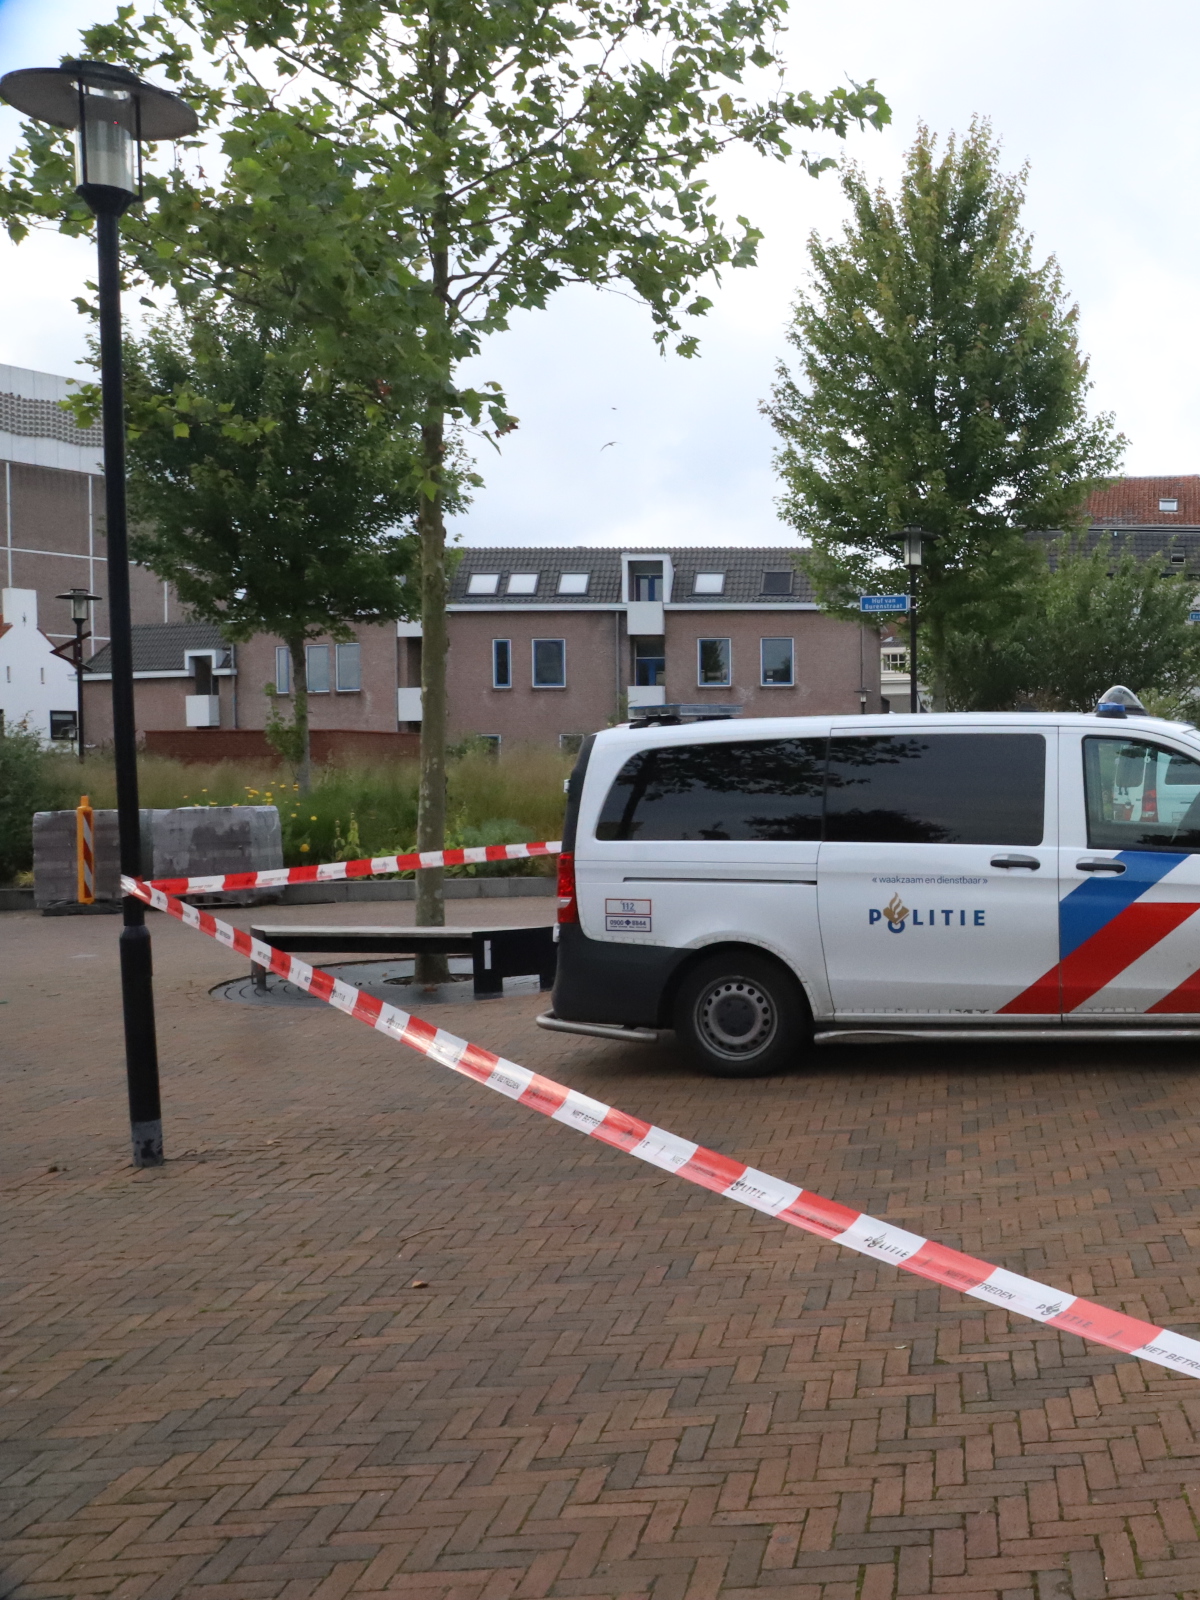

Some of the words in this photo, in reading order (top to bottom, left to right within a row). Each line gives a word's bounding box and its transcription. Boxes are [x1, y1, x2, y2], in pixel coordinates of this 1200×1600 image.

[879, 875, 924, 884] waakzaam
[937, 875, 981, 885] dienstbaar
[622, 902, 635, 911] 112
[869, 905, 985, 933] POLITIE
[864, 1233, 909, 1258] POLITIE
[944, 1269, 966, 1281] NIET
[965, 1277, 1016, 1301] BETREDEN
[1036, 1301, 1092, 1328] POLITIE
[1140, 1343, 1167, 1356] NIET
